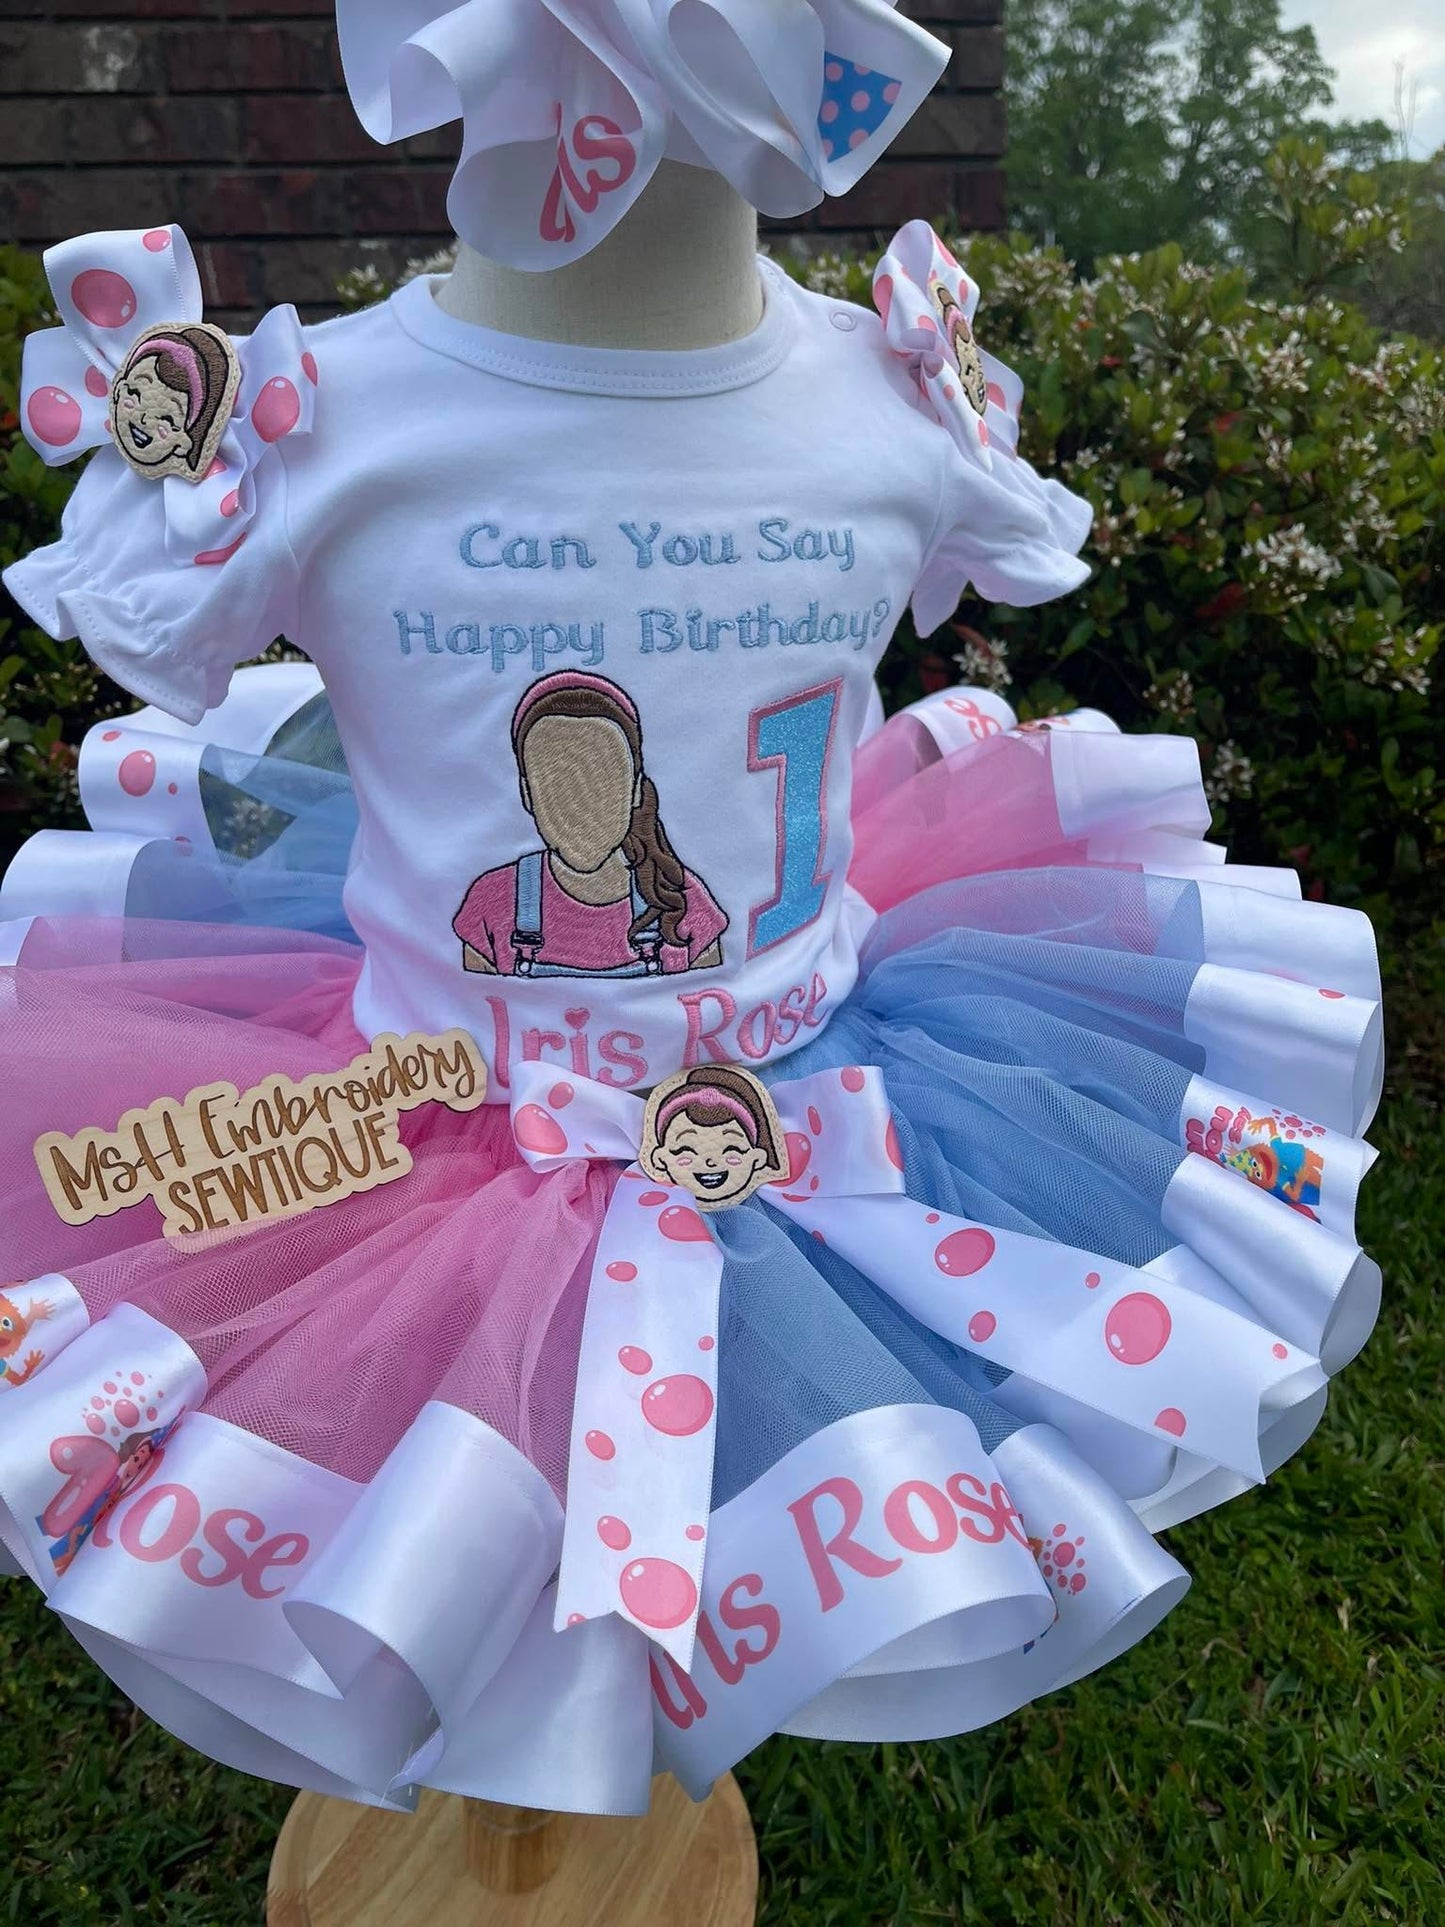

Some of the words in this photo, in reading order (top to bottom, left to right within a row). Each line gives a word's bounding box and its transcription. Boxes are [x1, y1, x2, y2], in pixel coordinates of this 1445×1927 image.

[459, 521, 596, 569] Can
[619, 521, 740, 569] You
[757, 518, 855, 571] Say
[394, 609, 605, 672] Happy
[637, 599, 889, 653] Birthday?
[746, 676, 844, 960] 1
[485, 996, 648, 1089] Iris
[677, 971, 830, 1069] Rose
[199, 1039, 476, 1160] Embroidery
[167, 1110, 400, 1236] SEWTIQUE
[92, 1450, 309, 1599] ose
